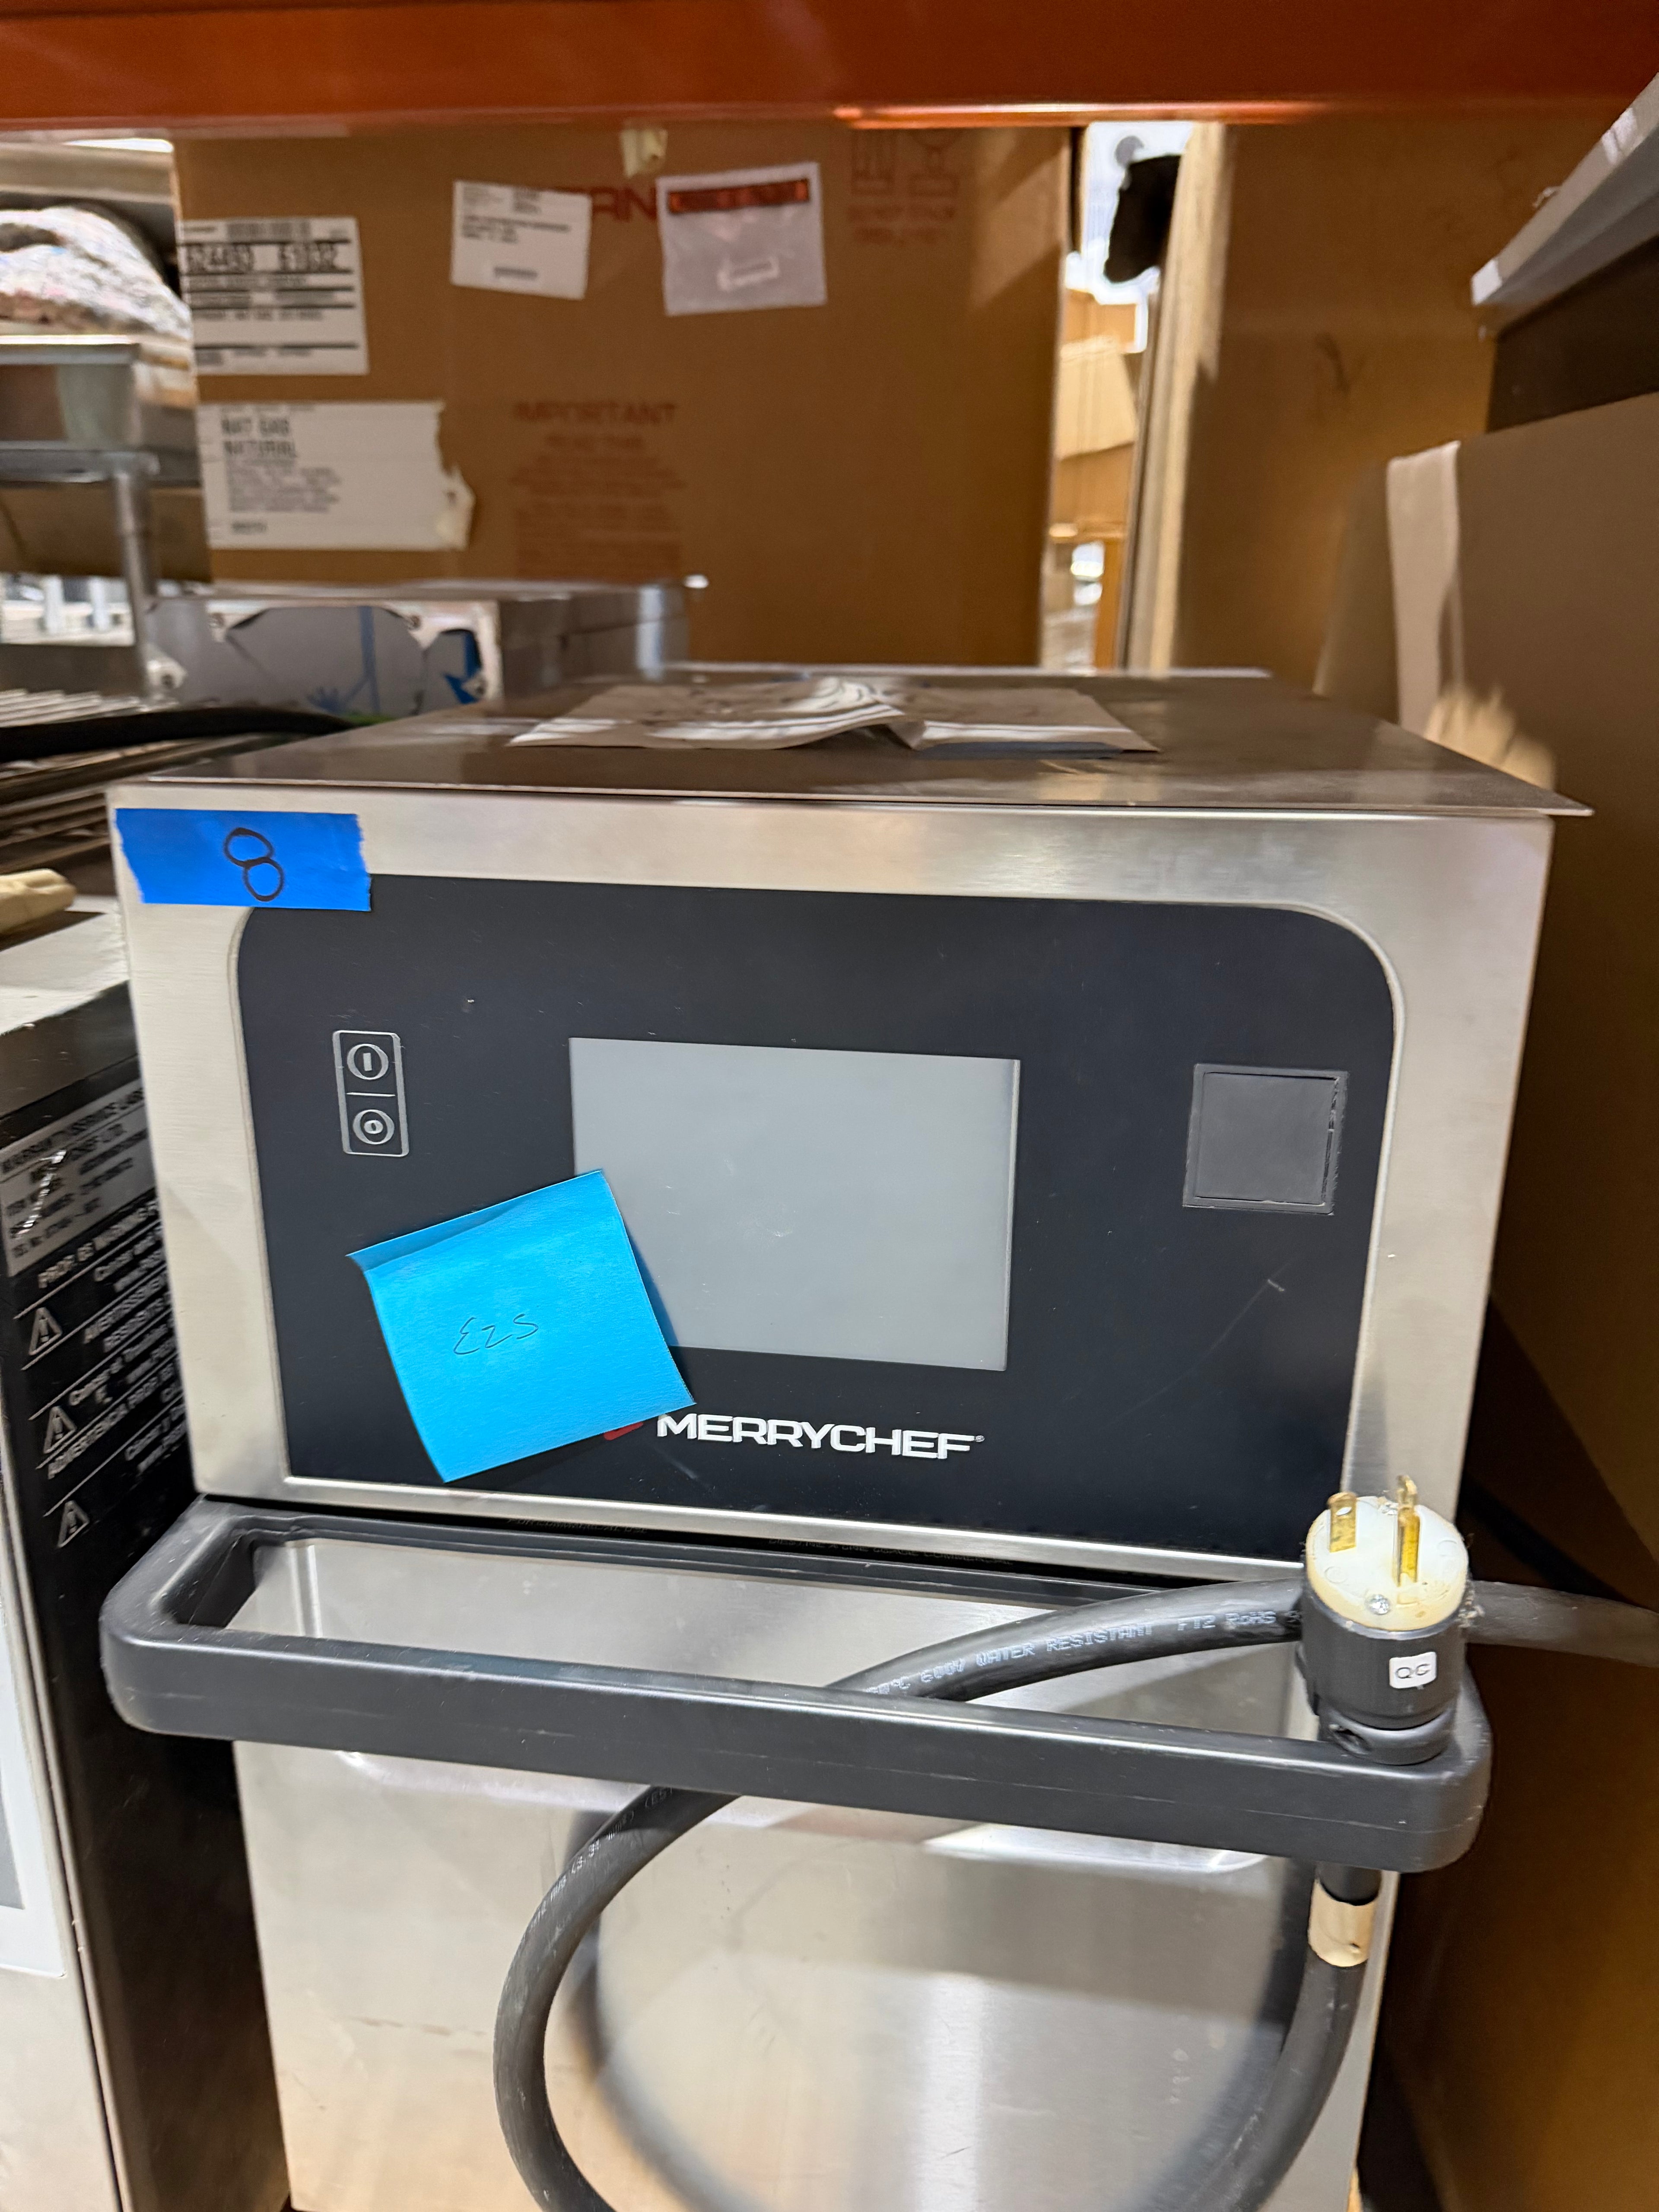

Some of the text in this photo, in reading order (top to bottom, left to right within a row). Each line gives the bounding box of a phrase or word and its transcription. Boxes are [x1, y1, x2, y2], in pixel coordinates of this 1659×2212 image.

[223, 827, 284, 902] 8
[975, 1642, 1036, 1667] WATER
[1046, 1624, 1153, 1652] RESISTANT
